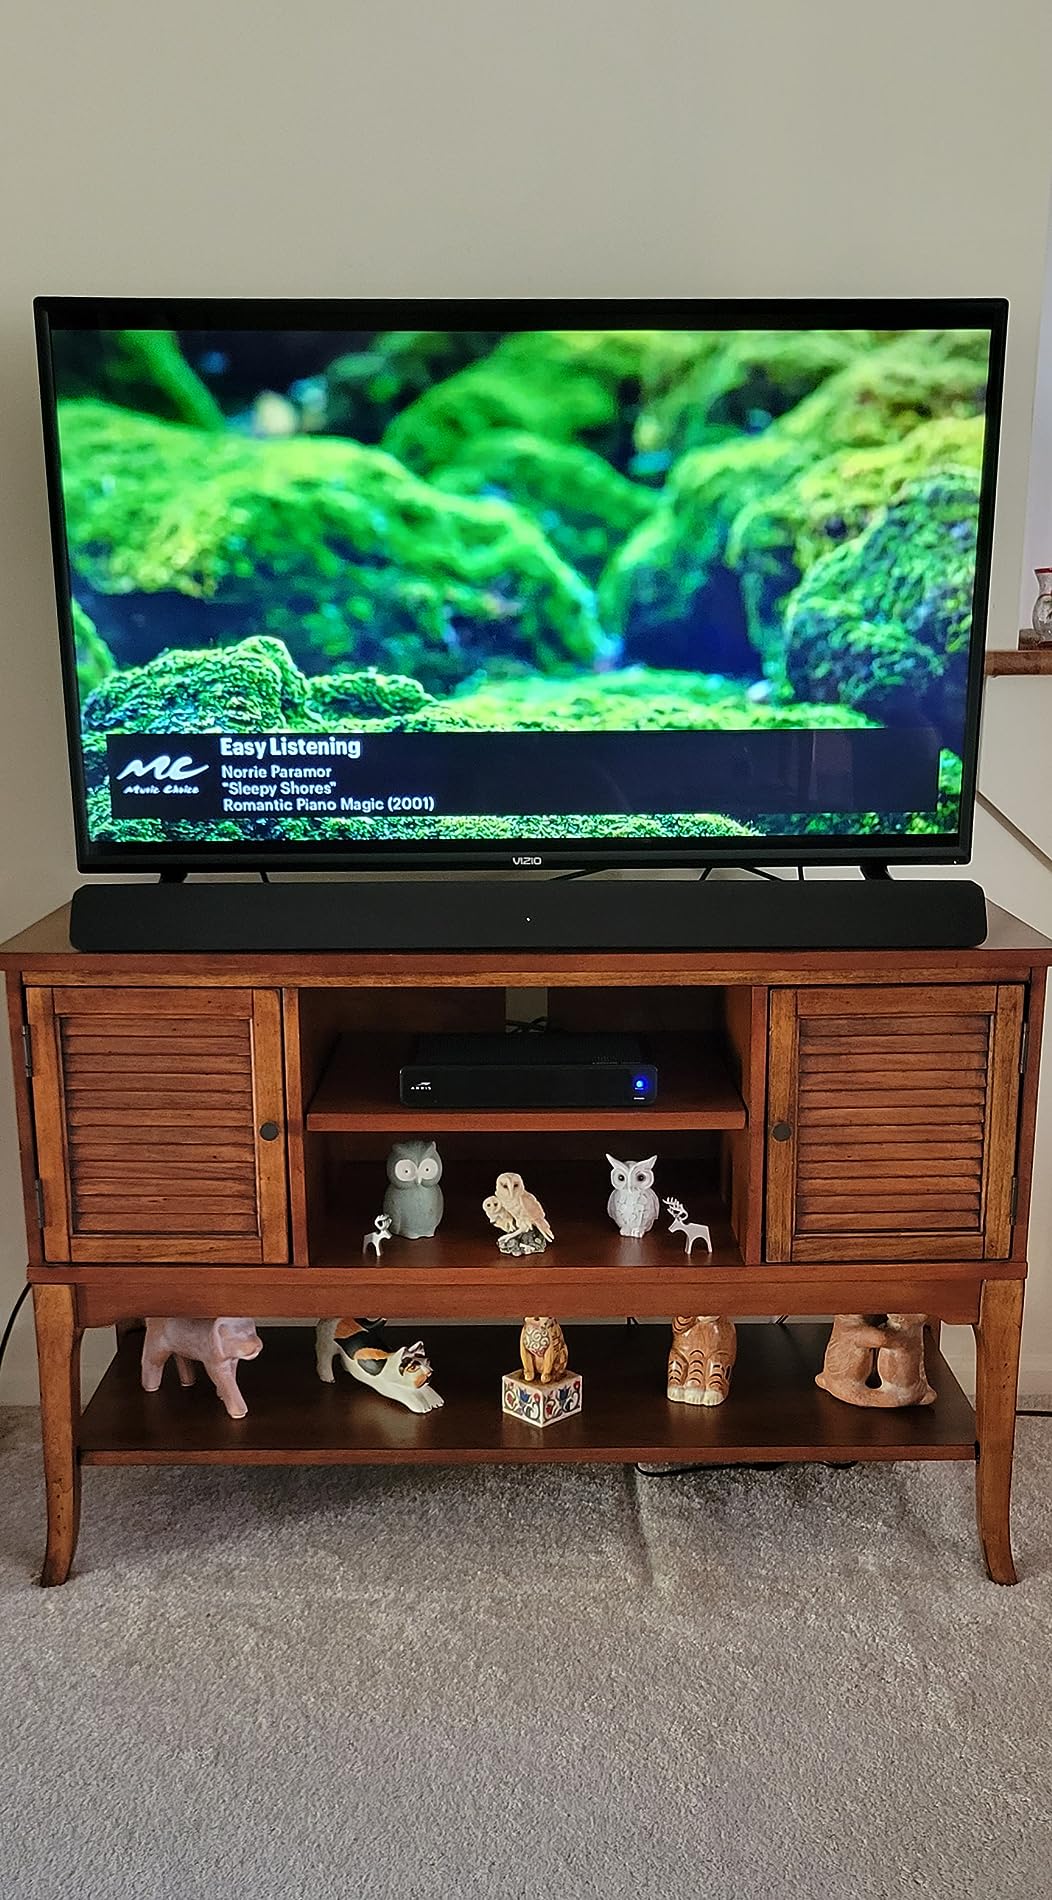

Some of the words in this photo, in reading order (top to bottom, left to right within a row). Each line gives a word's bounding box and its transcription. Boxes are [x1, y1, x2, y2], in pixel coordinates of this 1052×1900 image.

[219, 737, 267, 760] Easy
[269, 736, 361, 759] Listening
[116, 755, 210, 781] MC
[221, 765, 268, 779] Norrie
[270, 765, 332, 779] Paramor
[123, 785, 160, 795] Music
[163, 785, 200, 795] Choice
[223, 797, 294, 812] Romantic
[296, 797, 337, 811] Piano
[340, 797, 385, 814] Magic
[387, 795, 435, 812] (2001)
[512, 856, 542, 866] VIZIO
